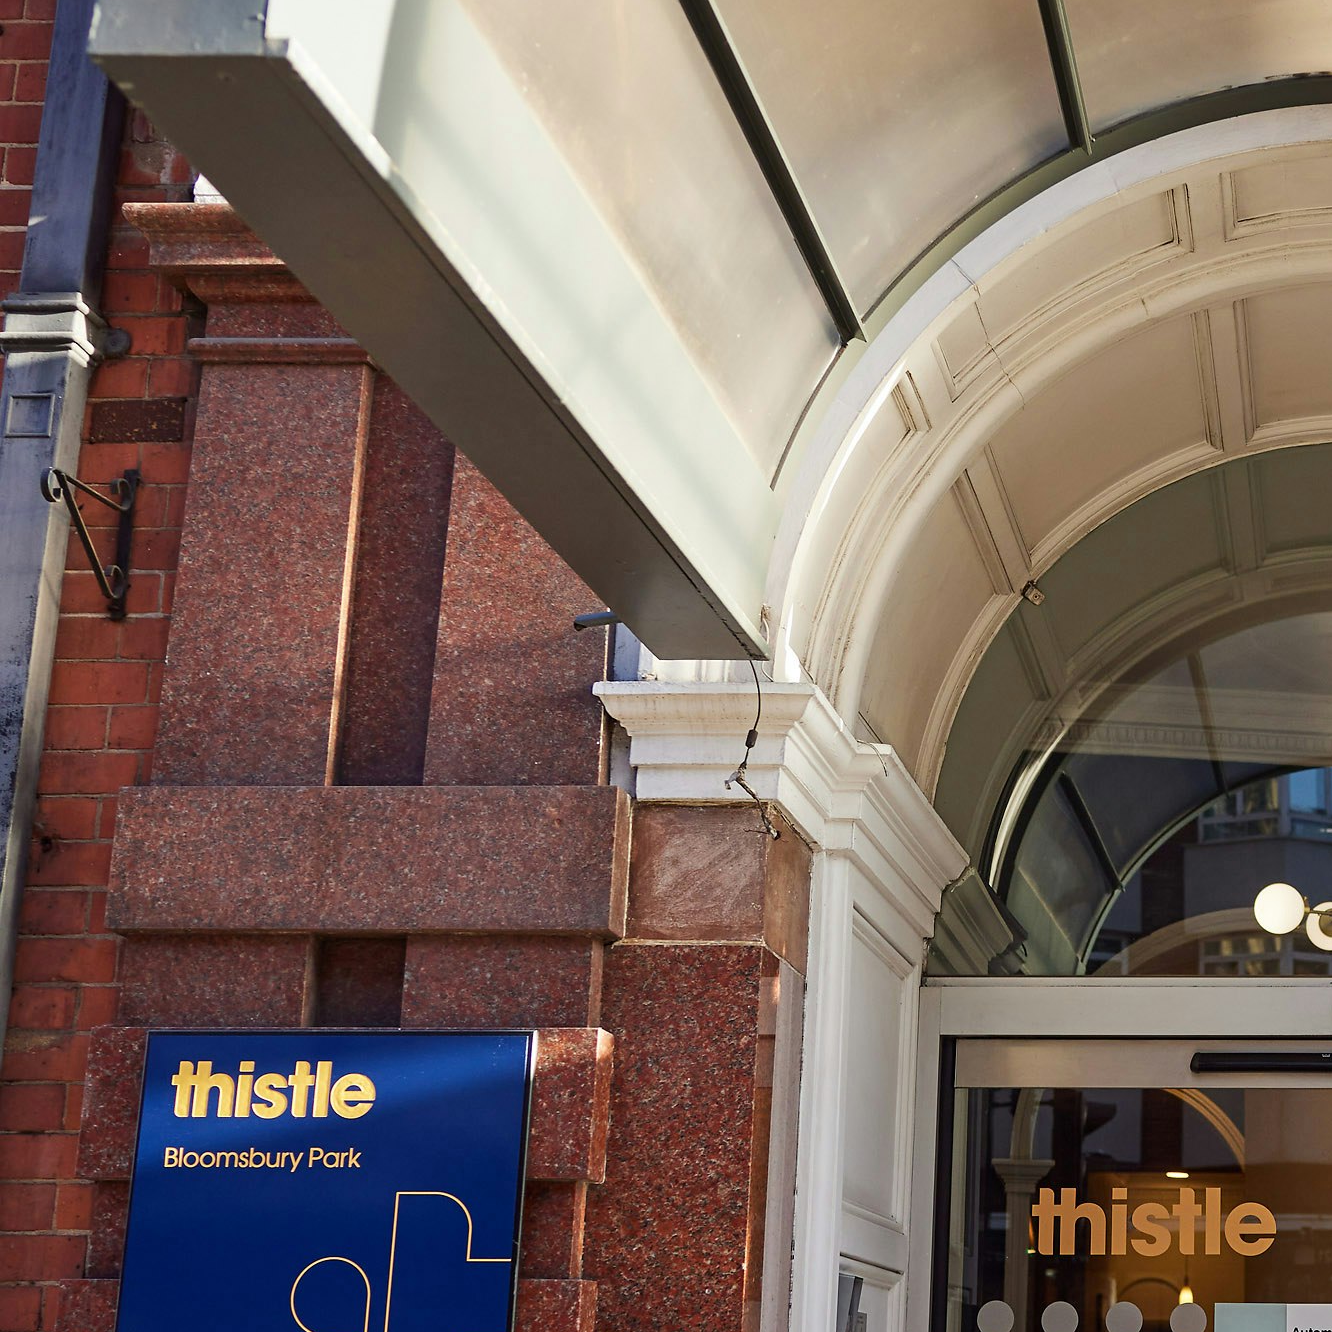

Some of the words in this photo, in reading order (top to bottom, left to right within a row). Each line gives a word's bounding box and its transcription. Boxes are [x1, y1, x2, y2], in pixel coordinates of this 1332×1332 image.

[171, 1060, 376, 1120] thistle
[164, 1147, 303, 1172] Bloomsbury
[308, 1147, 361, 1168] Park
[1032, 1187, 1276, 1257] thistle
